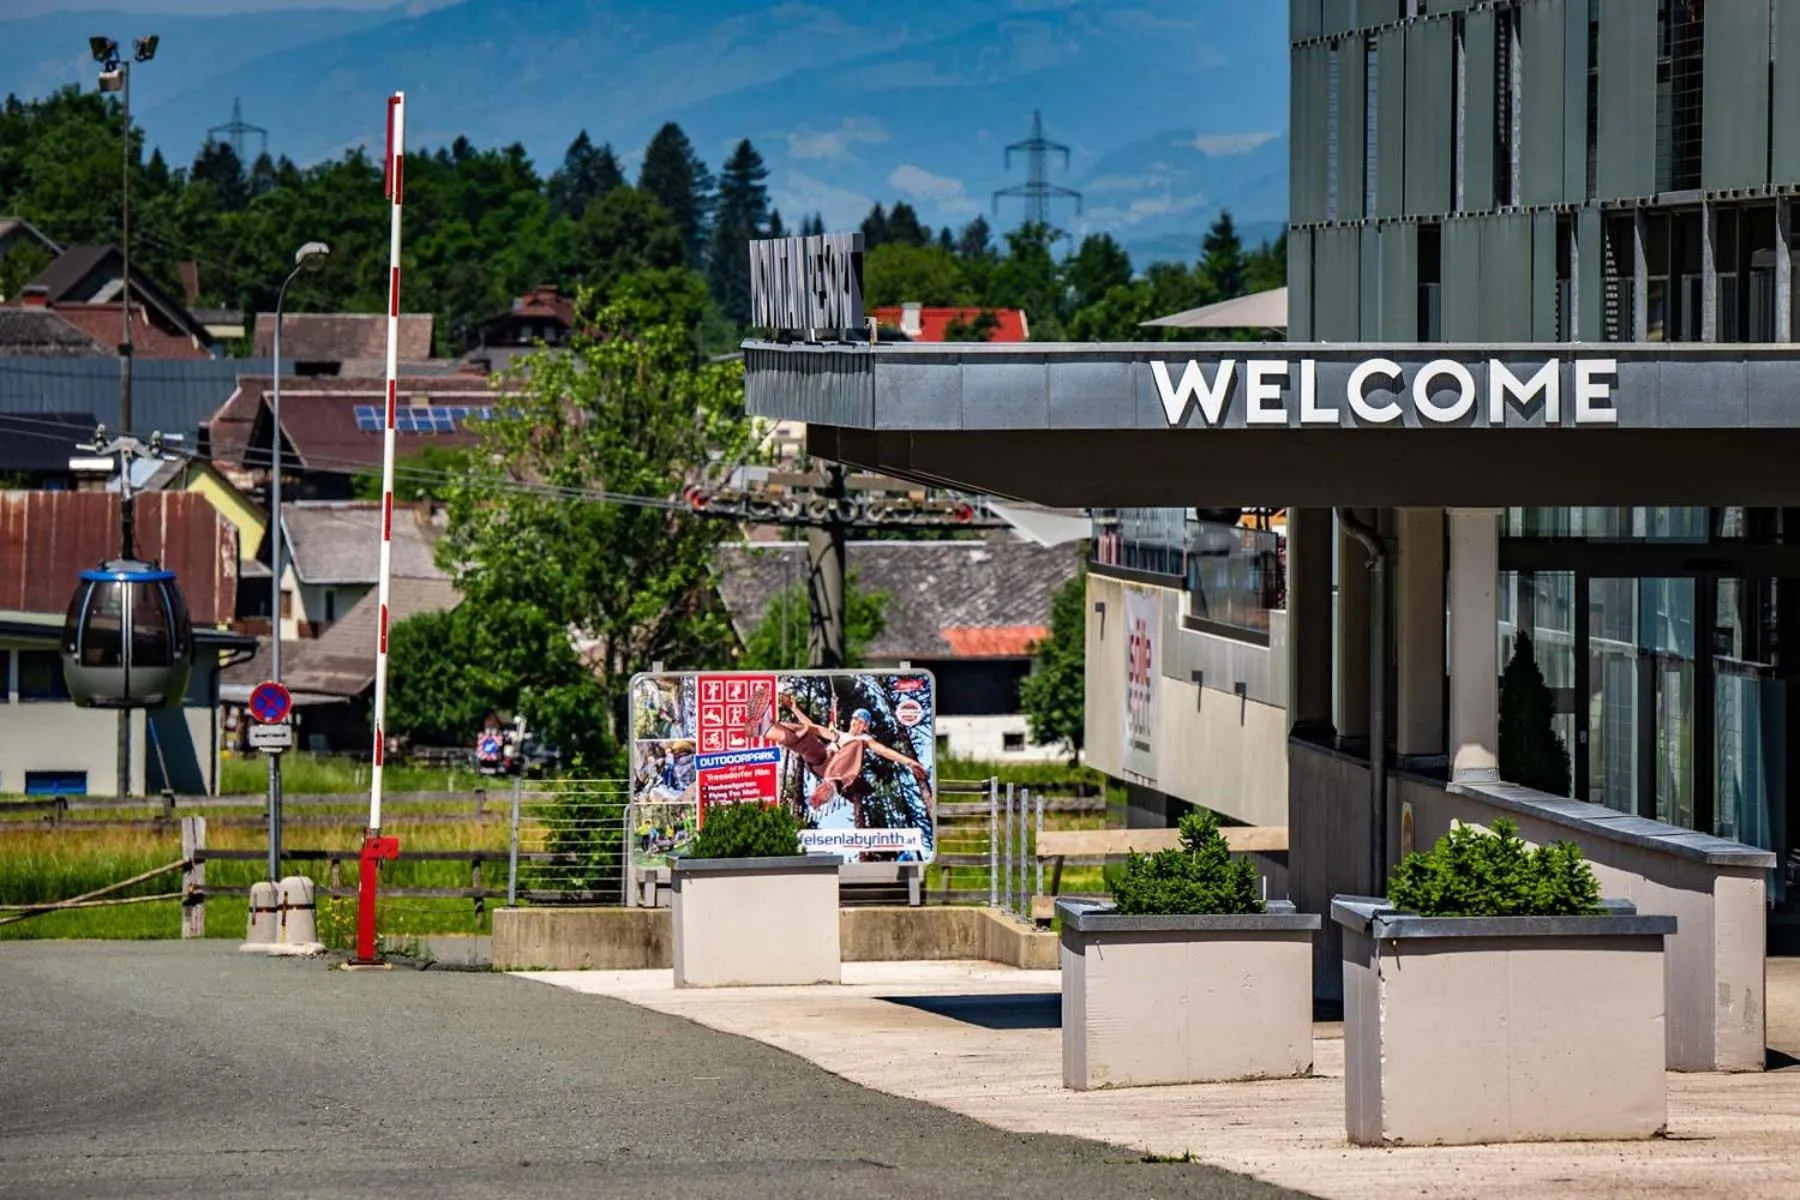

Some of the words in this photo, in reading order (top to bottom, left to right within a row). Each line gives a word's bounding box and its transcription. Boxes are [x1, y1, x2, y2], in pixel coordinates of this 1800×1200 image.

[807, 232, 864, 329] RESORT
[1150, 357, 1619, 425] WELCOME
[700, 751, 776, 767] OUTDOORPARK
